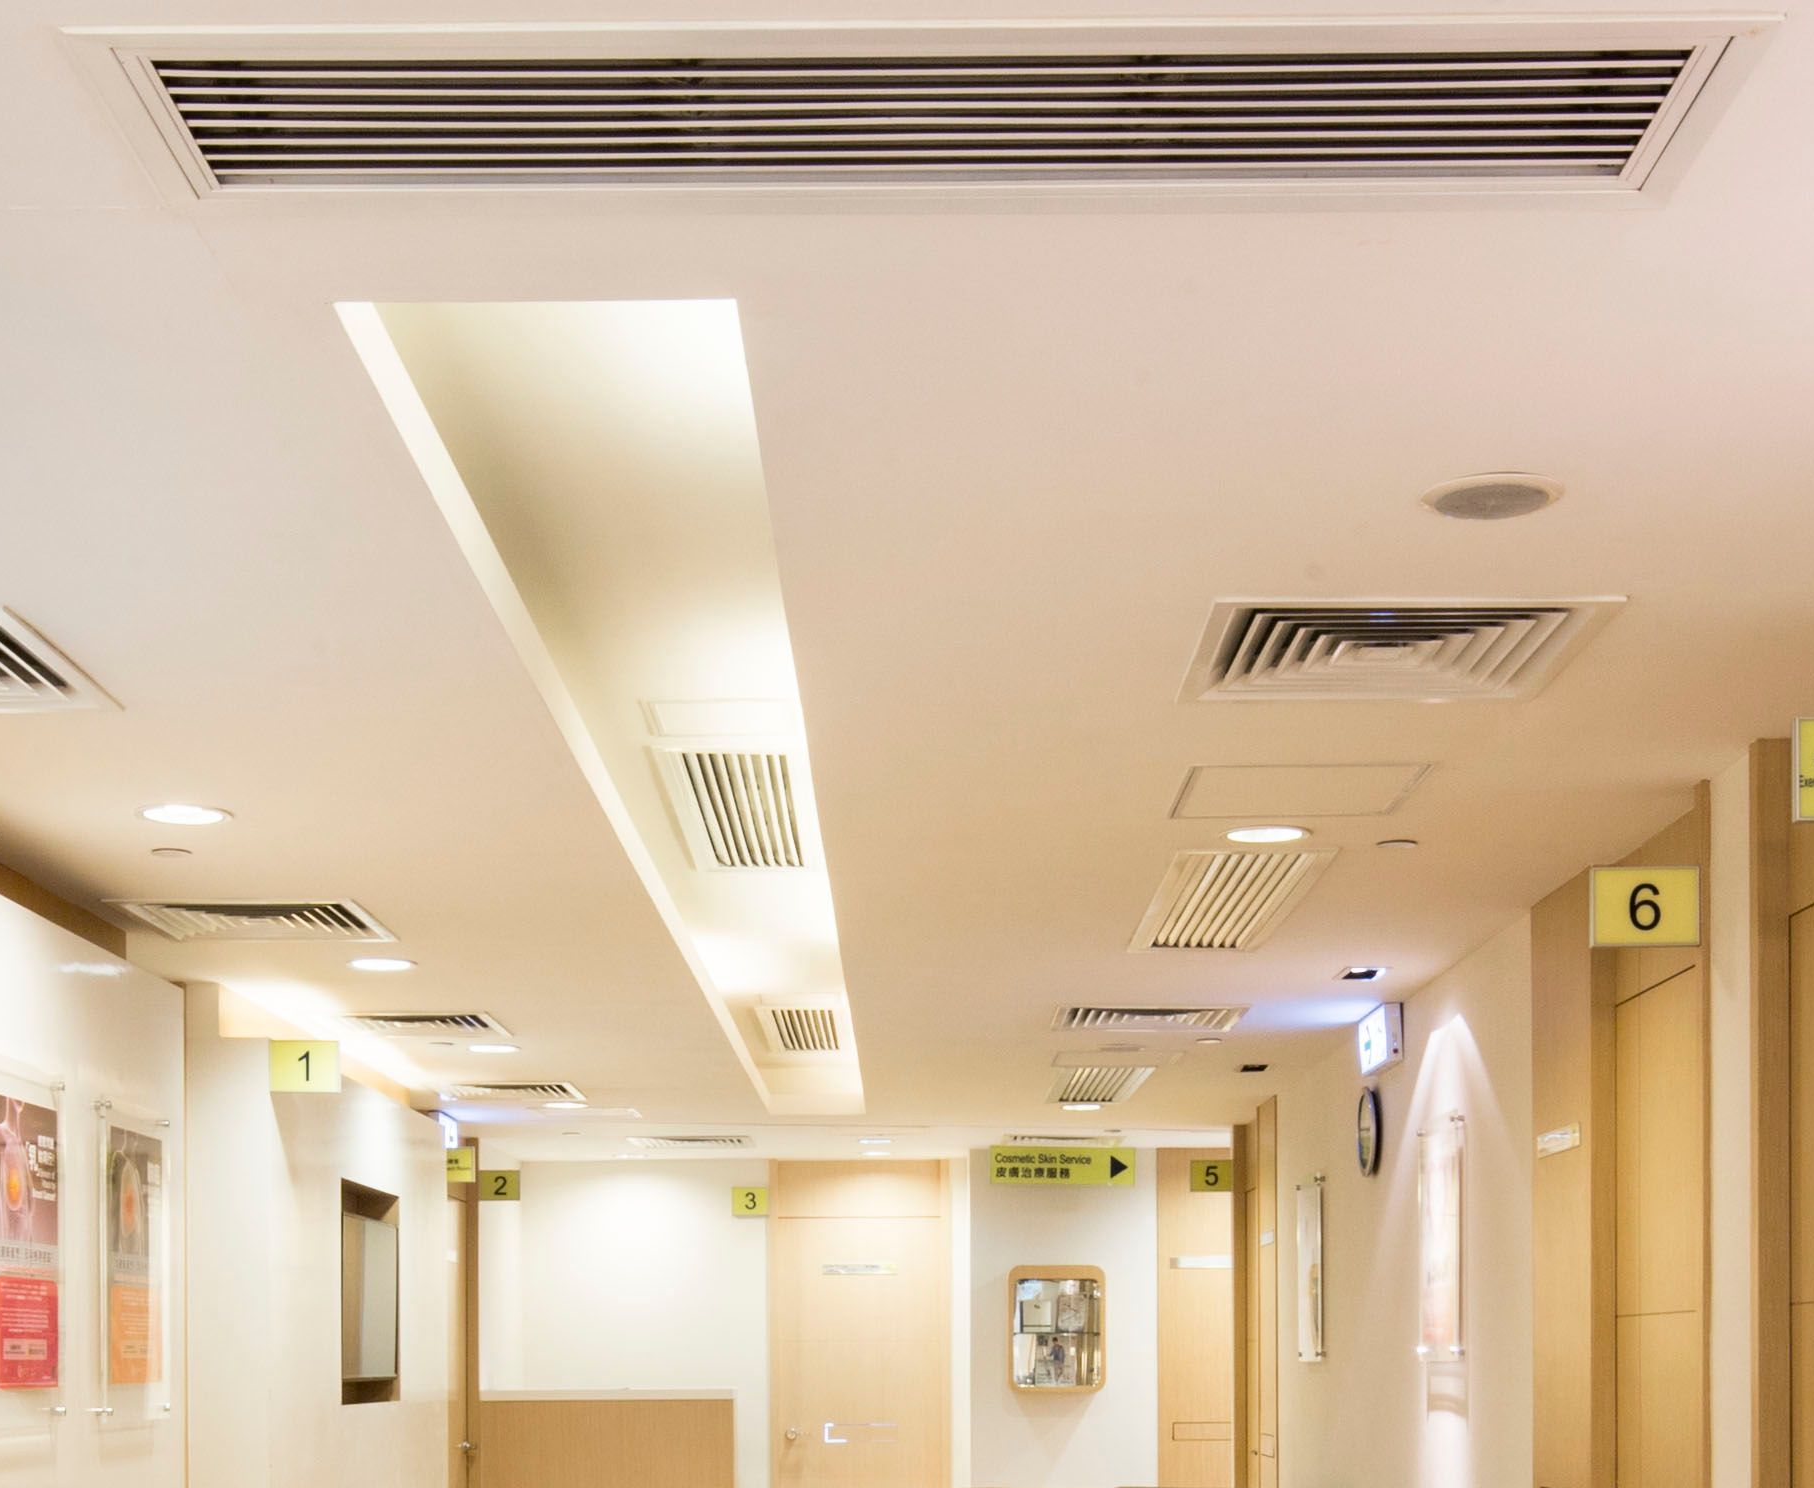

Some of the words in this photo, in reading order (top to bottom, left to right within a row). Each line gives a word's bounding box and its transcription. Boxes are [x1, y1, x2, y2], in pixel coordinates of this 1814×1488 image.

[1629, 883, 1661, 931] 6
[297, 1049, 311, 1082] 1
[994, 1153, 1035, 1164] Cosmetic
[1038, 1153, 1058, 1165] Skin
[1059, 1154, 1092, 1165] Service
[494, 1176, 507, 1195] 2
[1204, 1165, 1219, 1186] 5
[744, 1191, 757, 1210] 3
